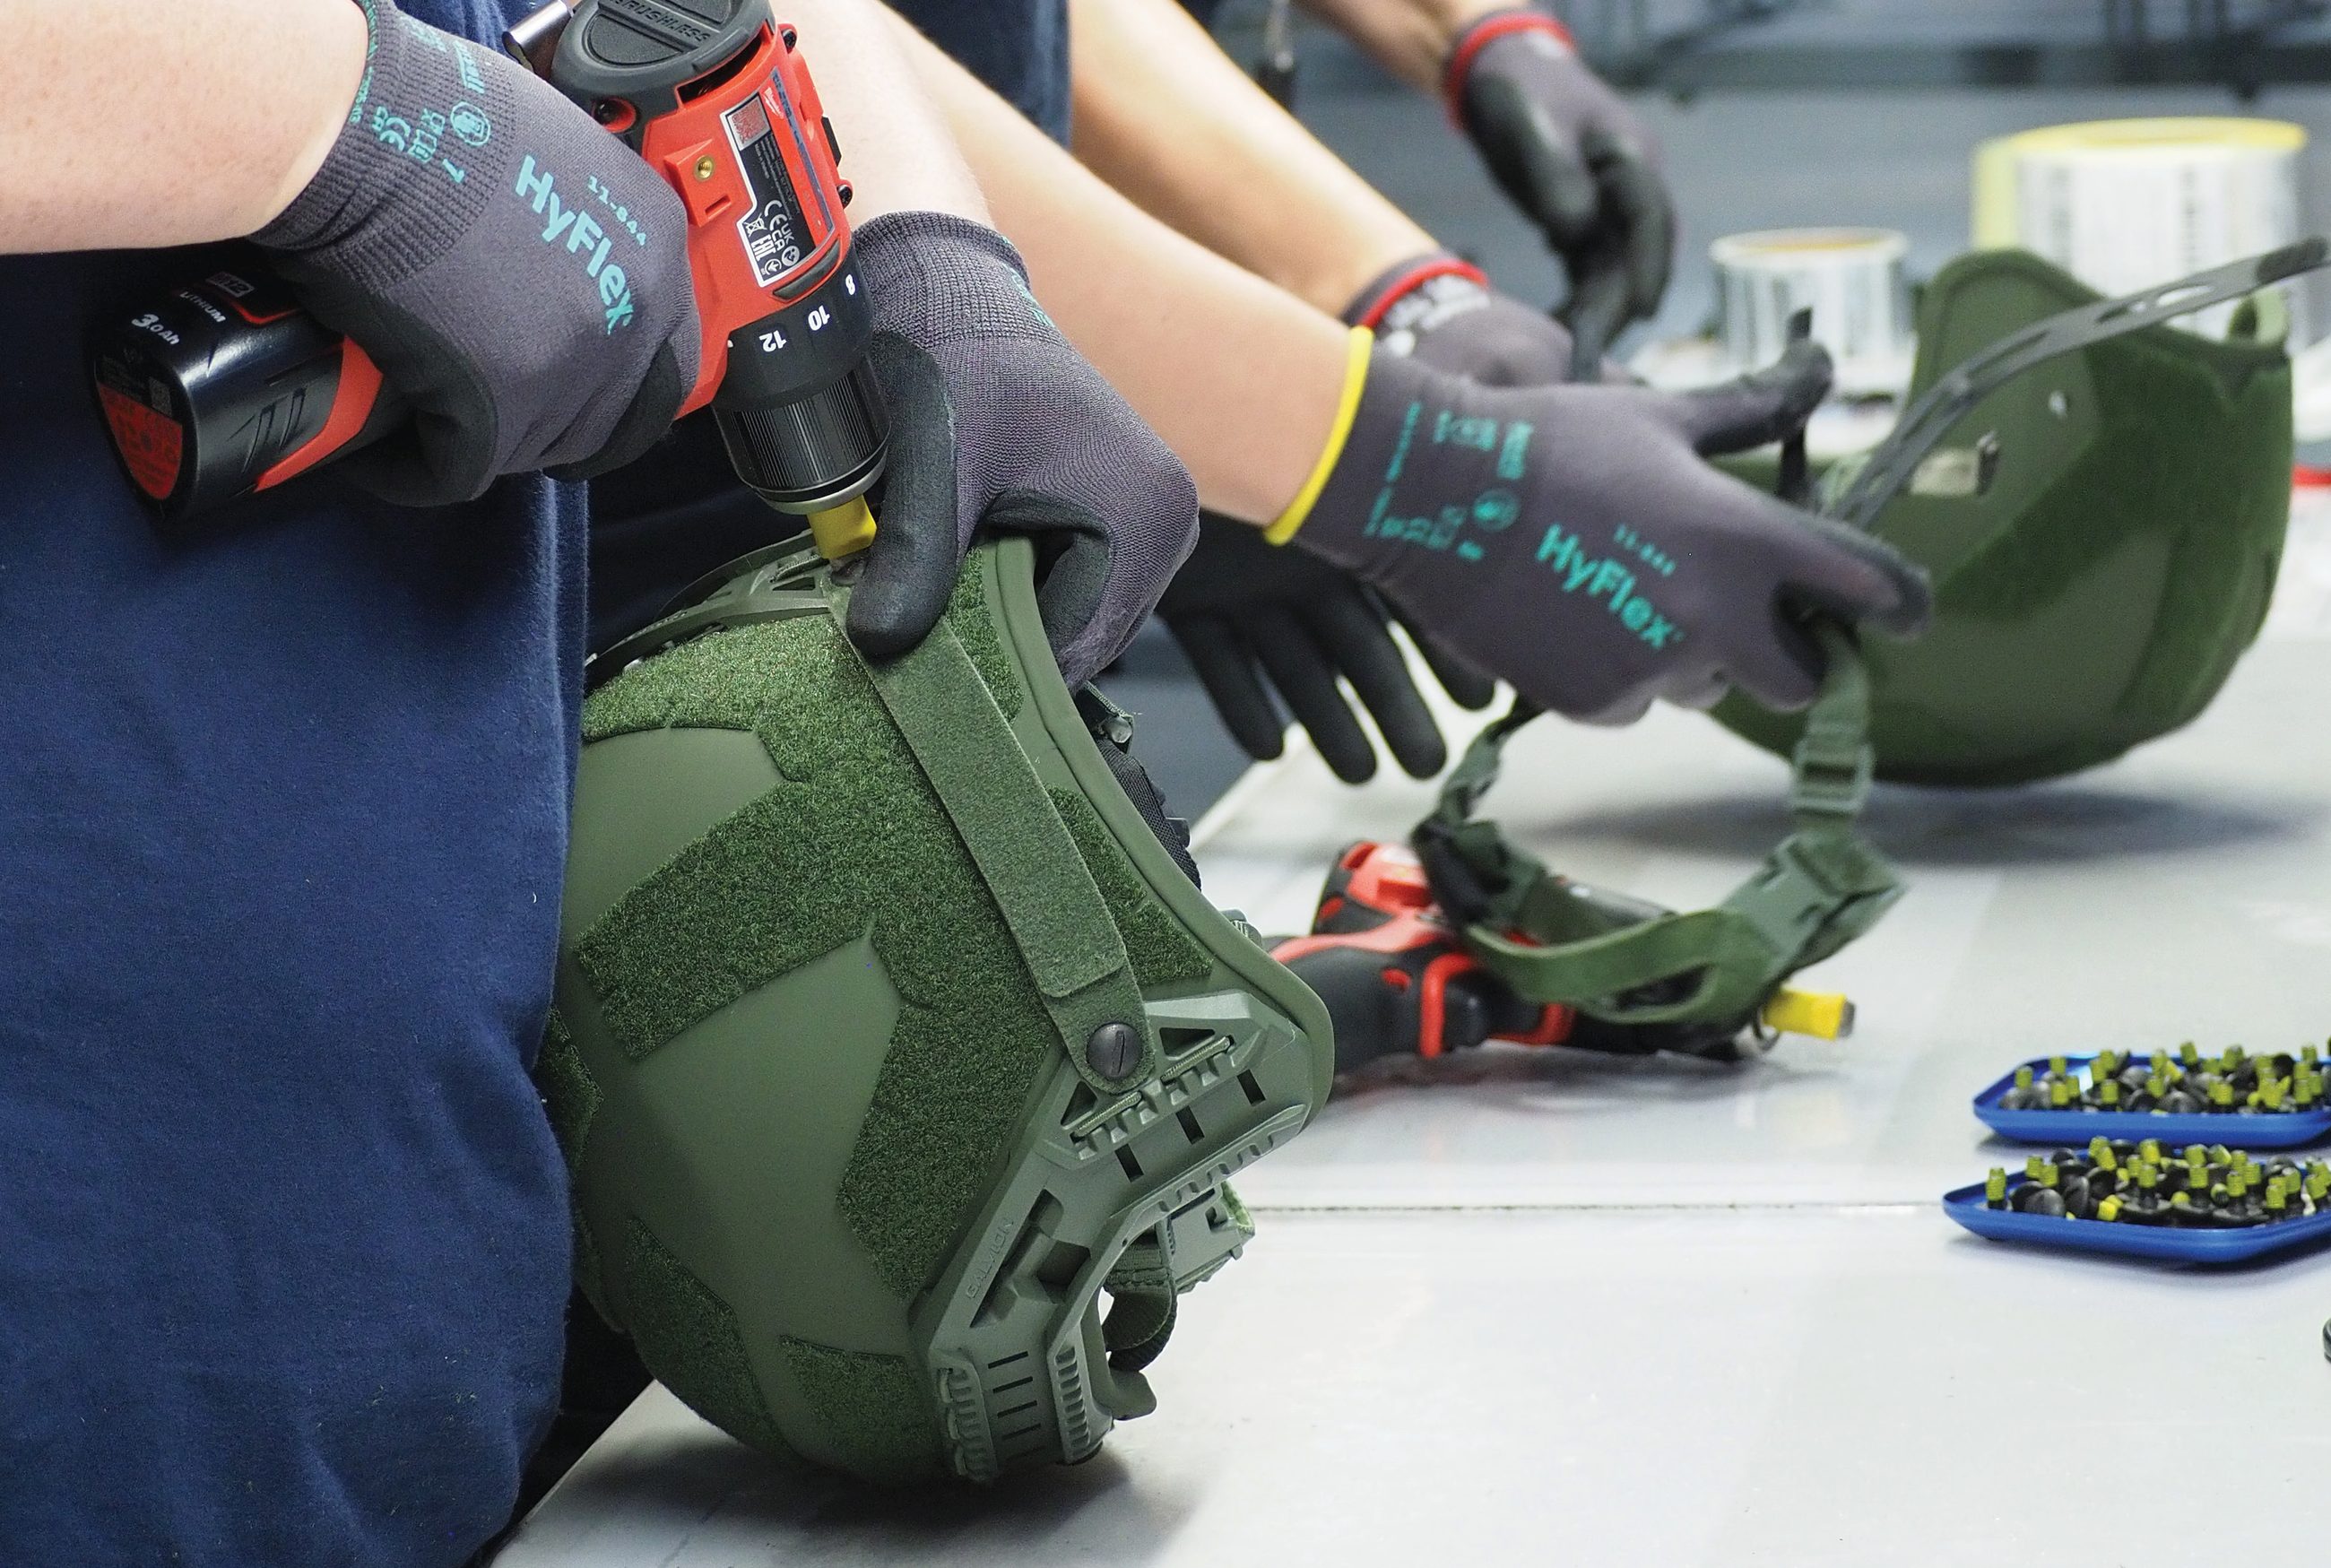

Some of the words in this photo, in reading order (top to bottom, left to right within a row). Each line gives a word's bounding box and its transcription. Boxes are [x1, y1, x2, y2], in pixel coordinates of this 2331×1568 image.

[515, 154, 635, 336] HyFlex
[845, 273, 856, 296] 8
[808, 305, 831, 332] 10
[758, 330, 787, 352] 12
[1536, 523, 1676, 650] HyFlex
